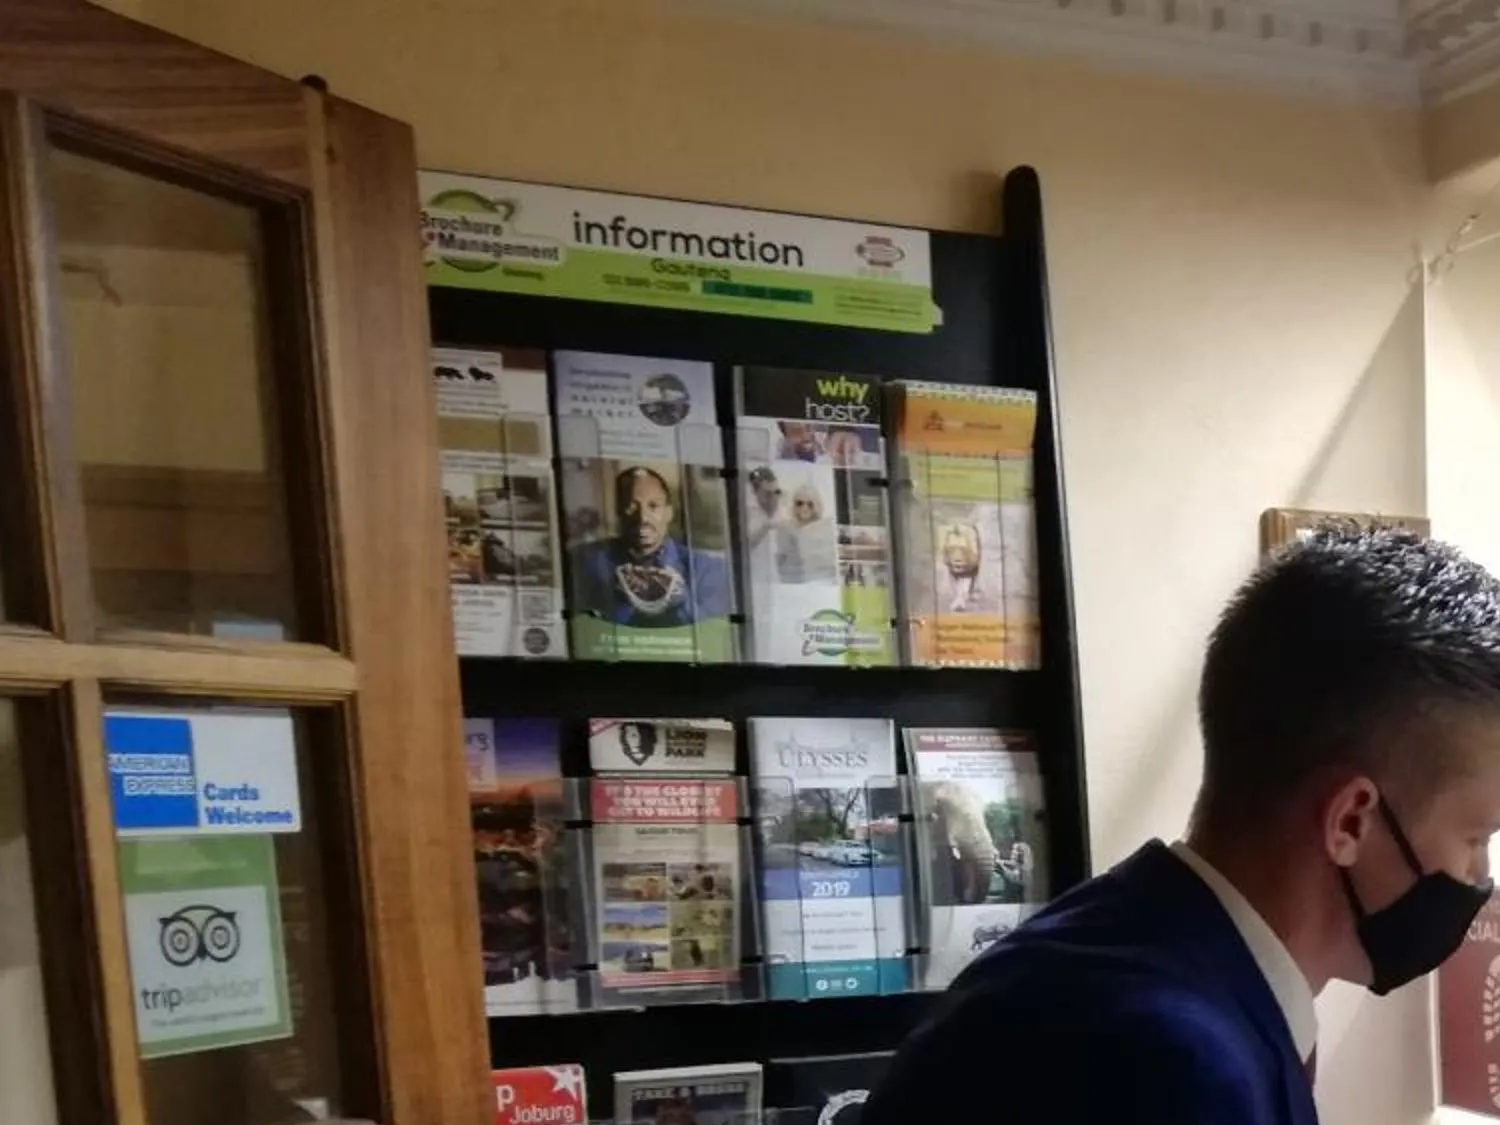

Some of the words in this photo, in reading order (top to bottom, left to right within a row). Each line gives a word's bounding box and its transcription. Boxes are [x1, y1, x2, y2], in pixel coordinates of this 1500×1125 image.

[572, 211, 805, 268] information
[816, 375, 869, 405] why
[804, 397, 871, 424] host?
[776, 748, 868, 769] ULYSSES
[203, 782, 260, 802] Cards
[204, 805, 294, 825] Welcome
[811, 879, 851, 898] 2019
[508, 1104, 576, 1125] Joburg
